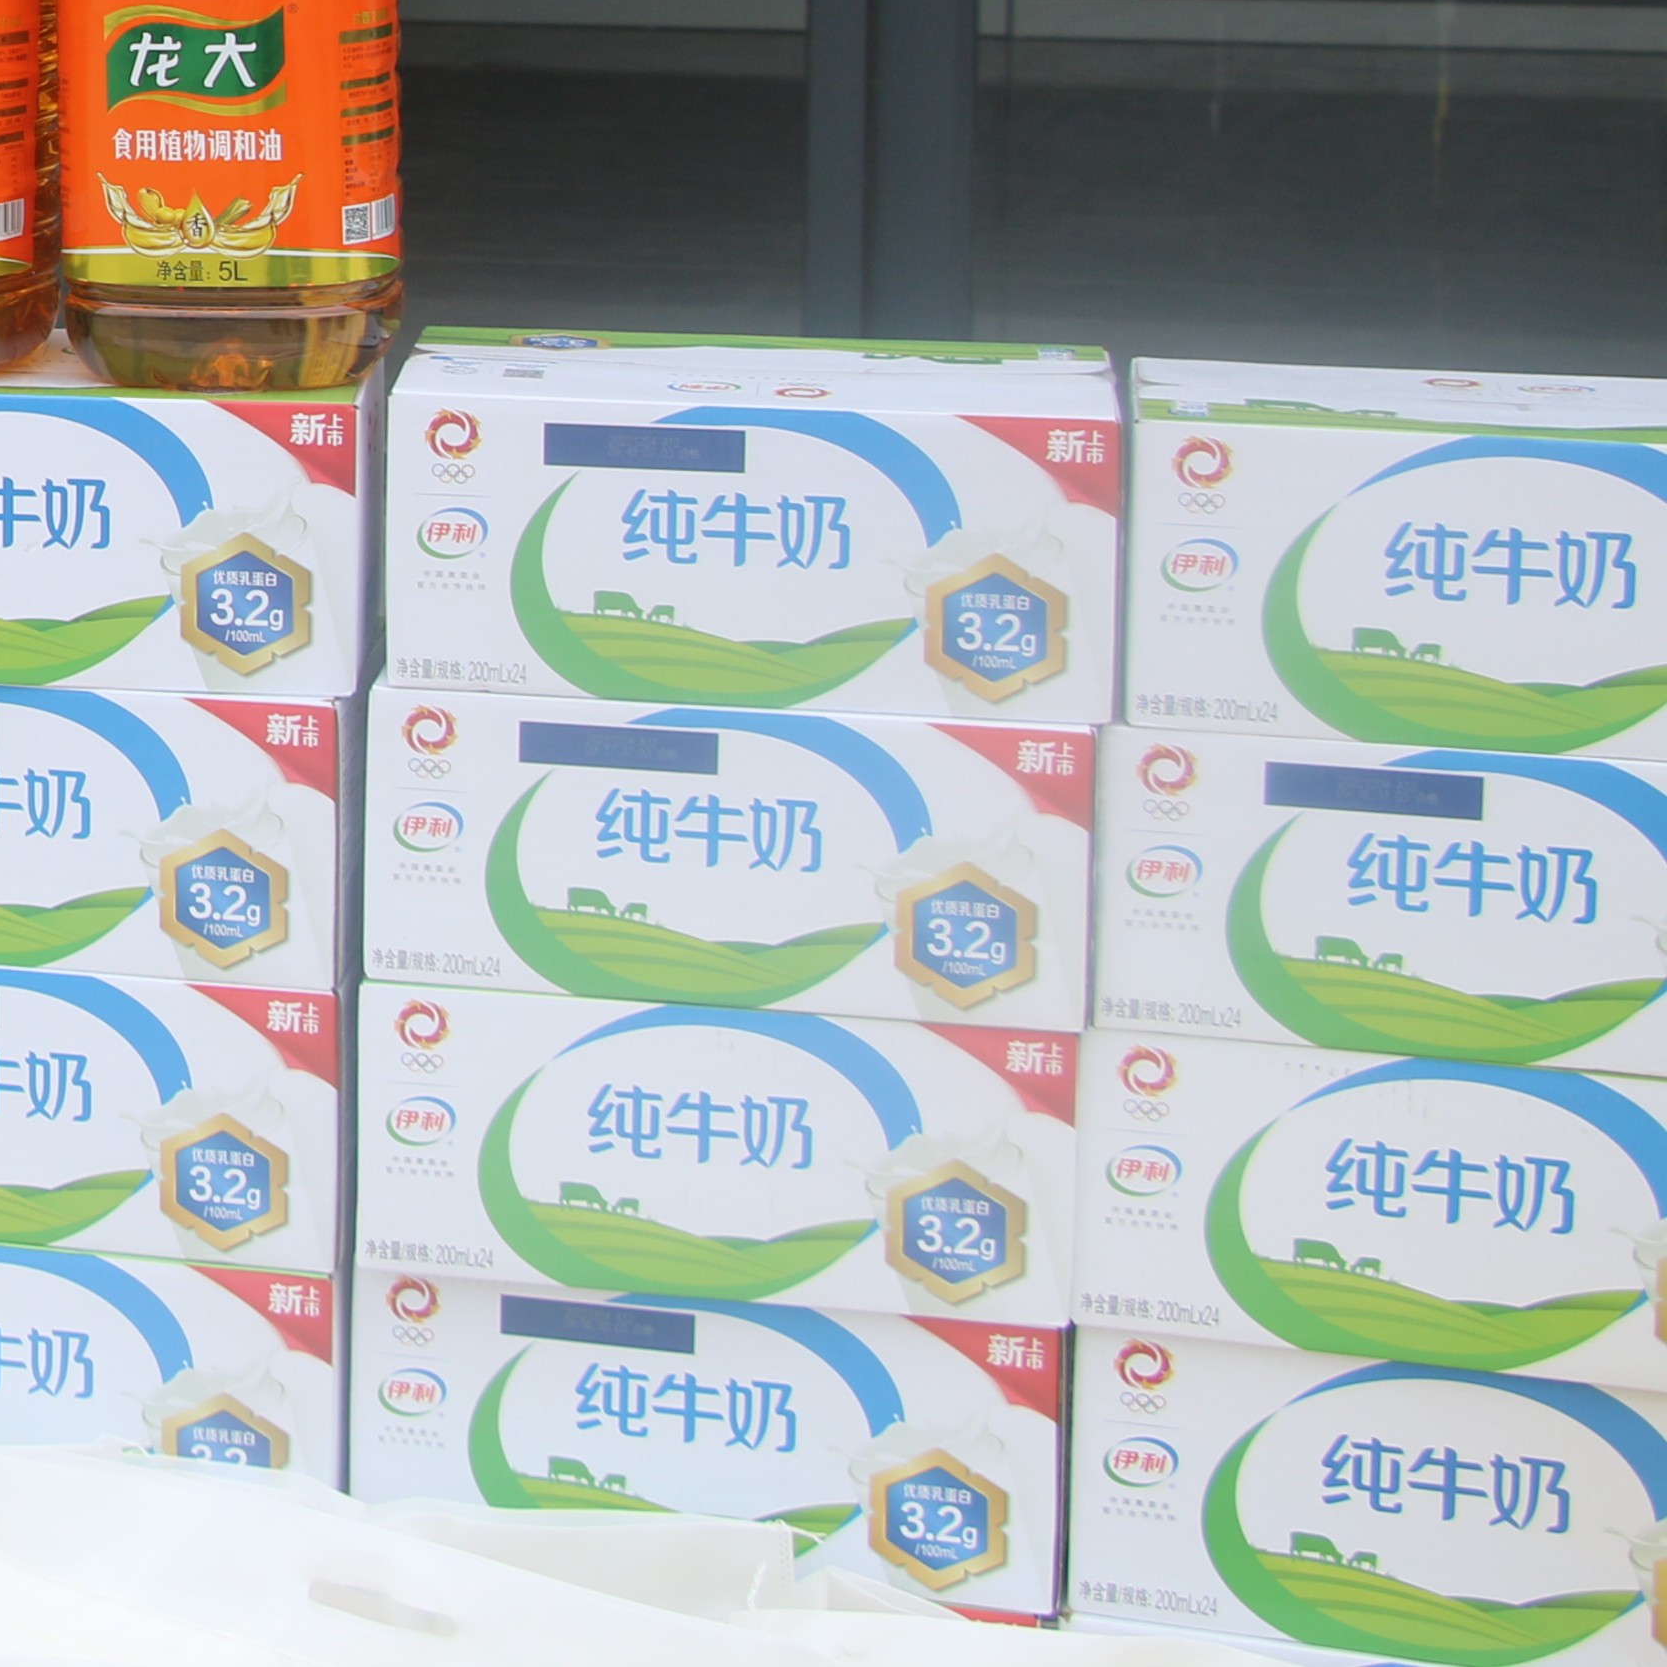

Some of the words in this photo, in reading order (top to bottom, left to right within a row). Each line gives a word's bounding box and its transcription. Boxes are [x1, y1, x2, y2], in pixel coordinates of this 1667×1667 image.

[129, 32, 257, 88] 龙大
[112, 128, 283, 163] 食用植物调和油
[426, 520, 480, 547] 伊利
[621, 489, 852, 570] 纯牛奶
[1171, 554, 1226, 577] 伊利
[1383, 522, 1636, 609] 纯牛奶
[210, 589, 284, 633] 3.2g
[956, 612, 1036, 658] 3.2g
[402, 814, 453, 840] 伊利
[595, 788, 823, 873] 纯牛奶
[1135, 859, 1191, 883] 伊利
[1346, 832, 1597, 924] 纯牛奶
[188, 884, 261, 928] 3.2g
[926, 919, 1006, 964] 3.2g
[394, 1110, 446, 1133] 伊利
[586, 1084, 813, 1170] 纯牛奶
[188, 1166, 261, 1210] 3.2g
[1116, 1158, 1169, 1182] 伊利
[1324, 1138, 1575, 1235] 纯牛奶
[916, 1217, 996, 1261] 3.2g
[387, 1379, 437, 1406] 伊利
[574, 1362, 798, 1454] 纯牛奶
[1113, 1448, 1166, 1474] 伊利
[1320, 1434, 1570, 1534] 纯牛奶
[898, 1503, 978, 1548] 3.2g
